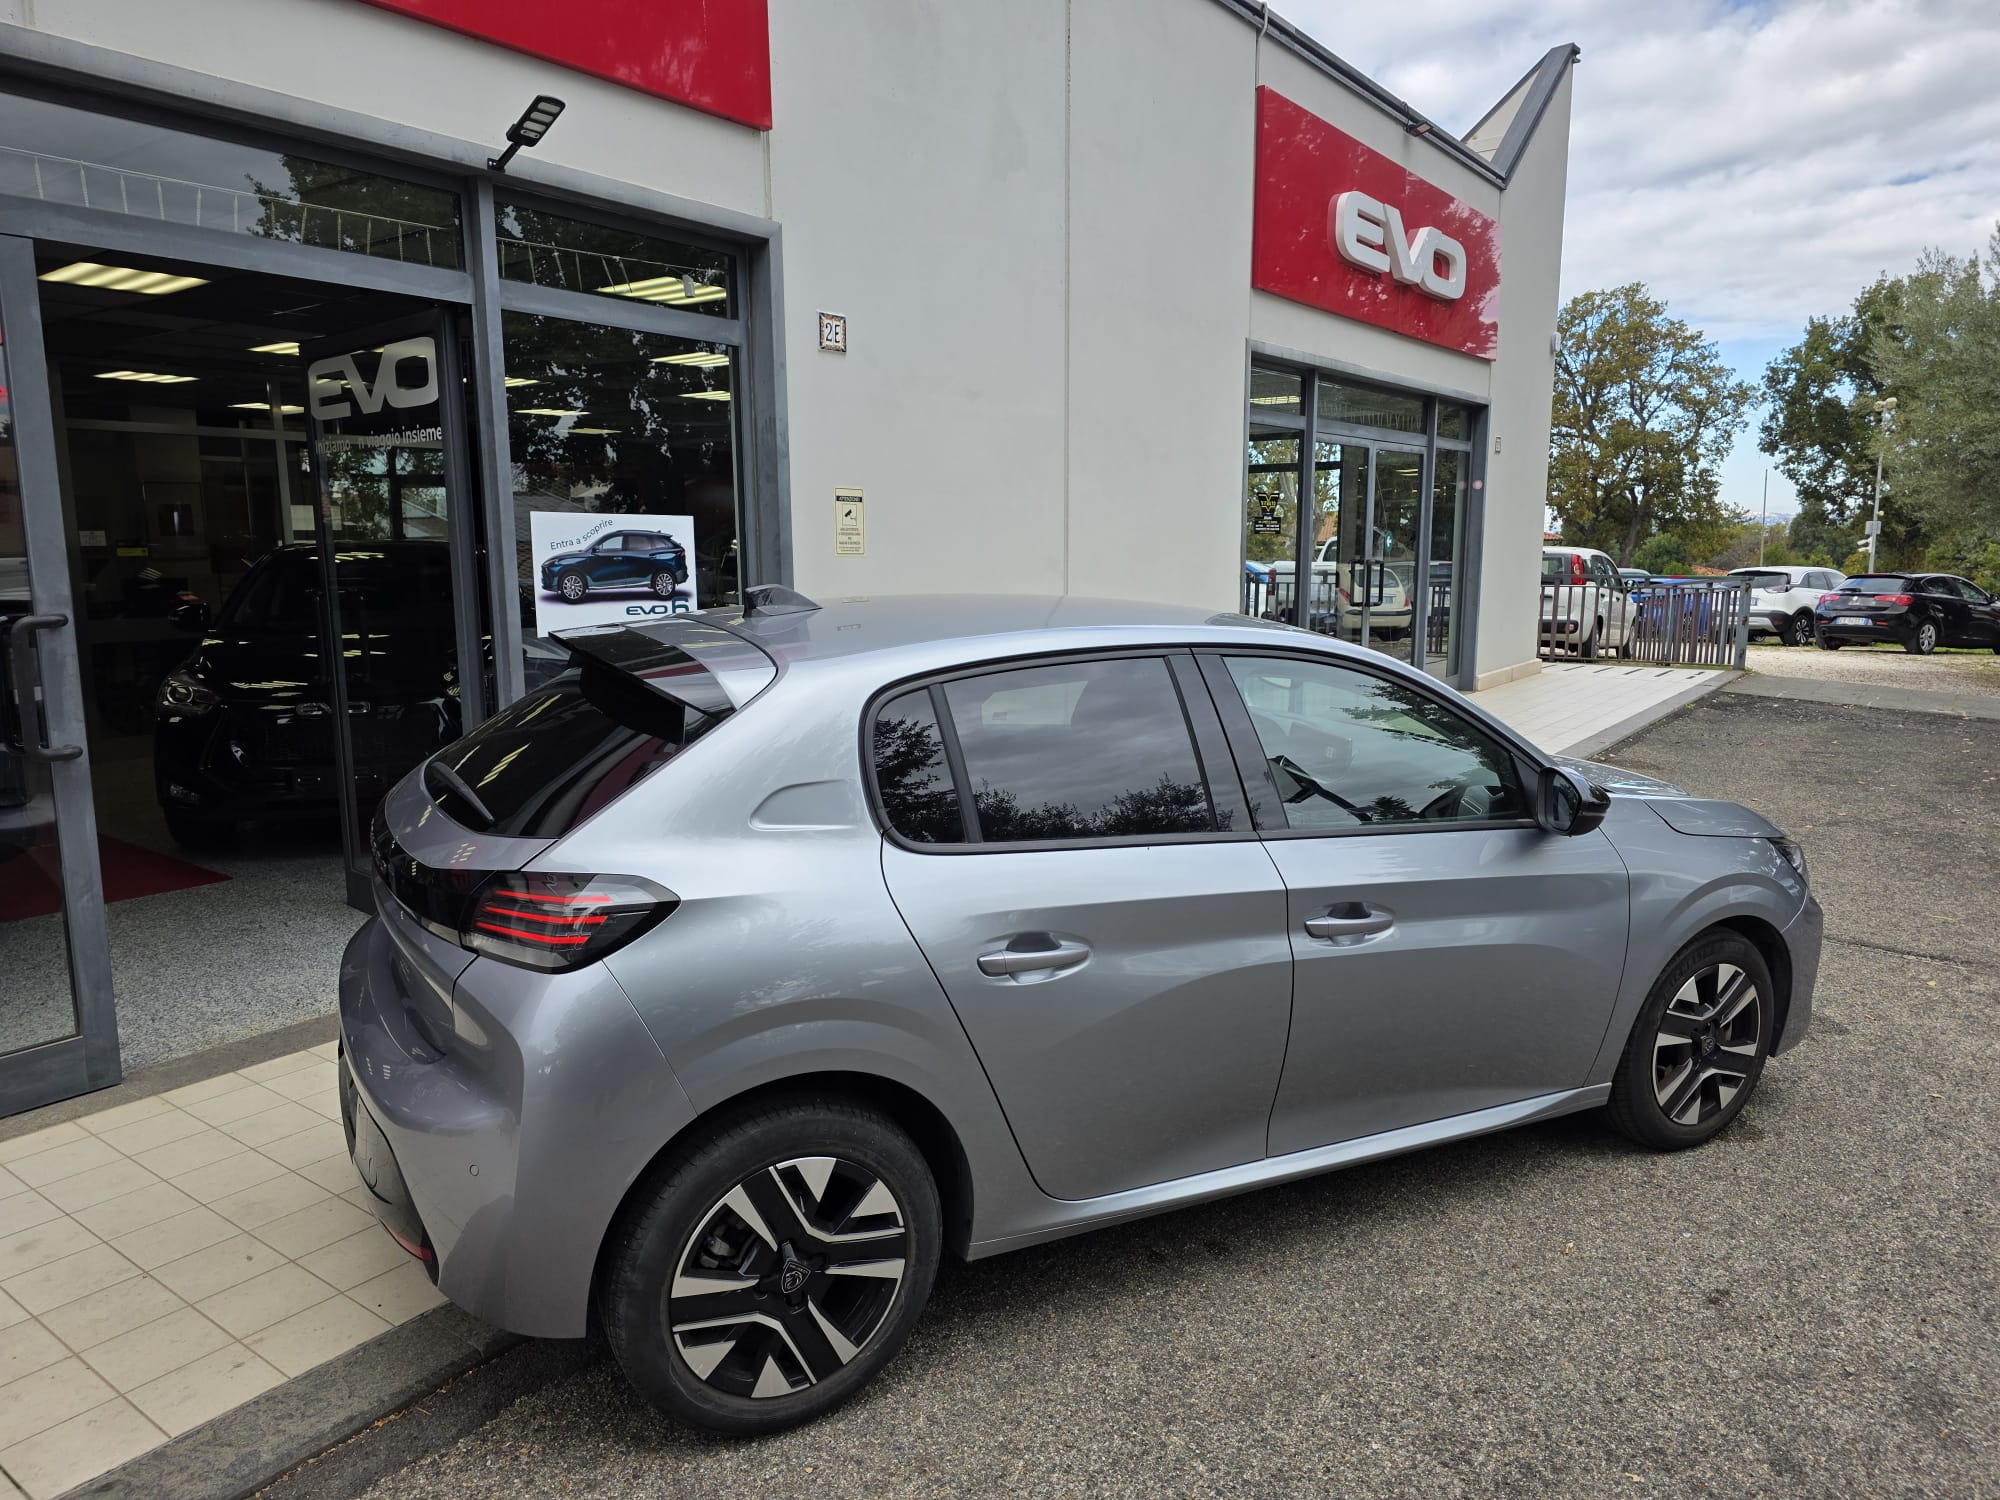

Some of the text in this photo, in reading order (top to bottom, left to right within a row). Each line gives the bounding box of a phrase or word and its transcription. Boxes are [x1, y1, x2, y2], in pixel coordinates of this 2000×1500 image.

[1335, 190, 1467, 300] EVO
[825, 322, 840, 344] 2E
[308, 336, 439, 421] EVO
[314, 435, 351, 455] Iniziamo
[366, 428, 401, 450] viaggio
[402, 424, 443, 444] insieme
[550, 540, 574, 551] Entra
[582, 519, 614, 543] scoprire
[625, 604, 669, 616] EVO
